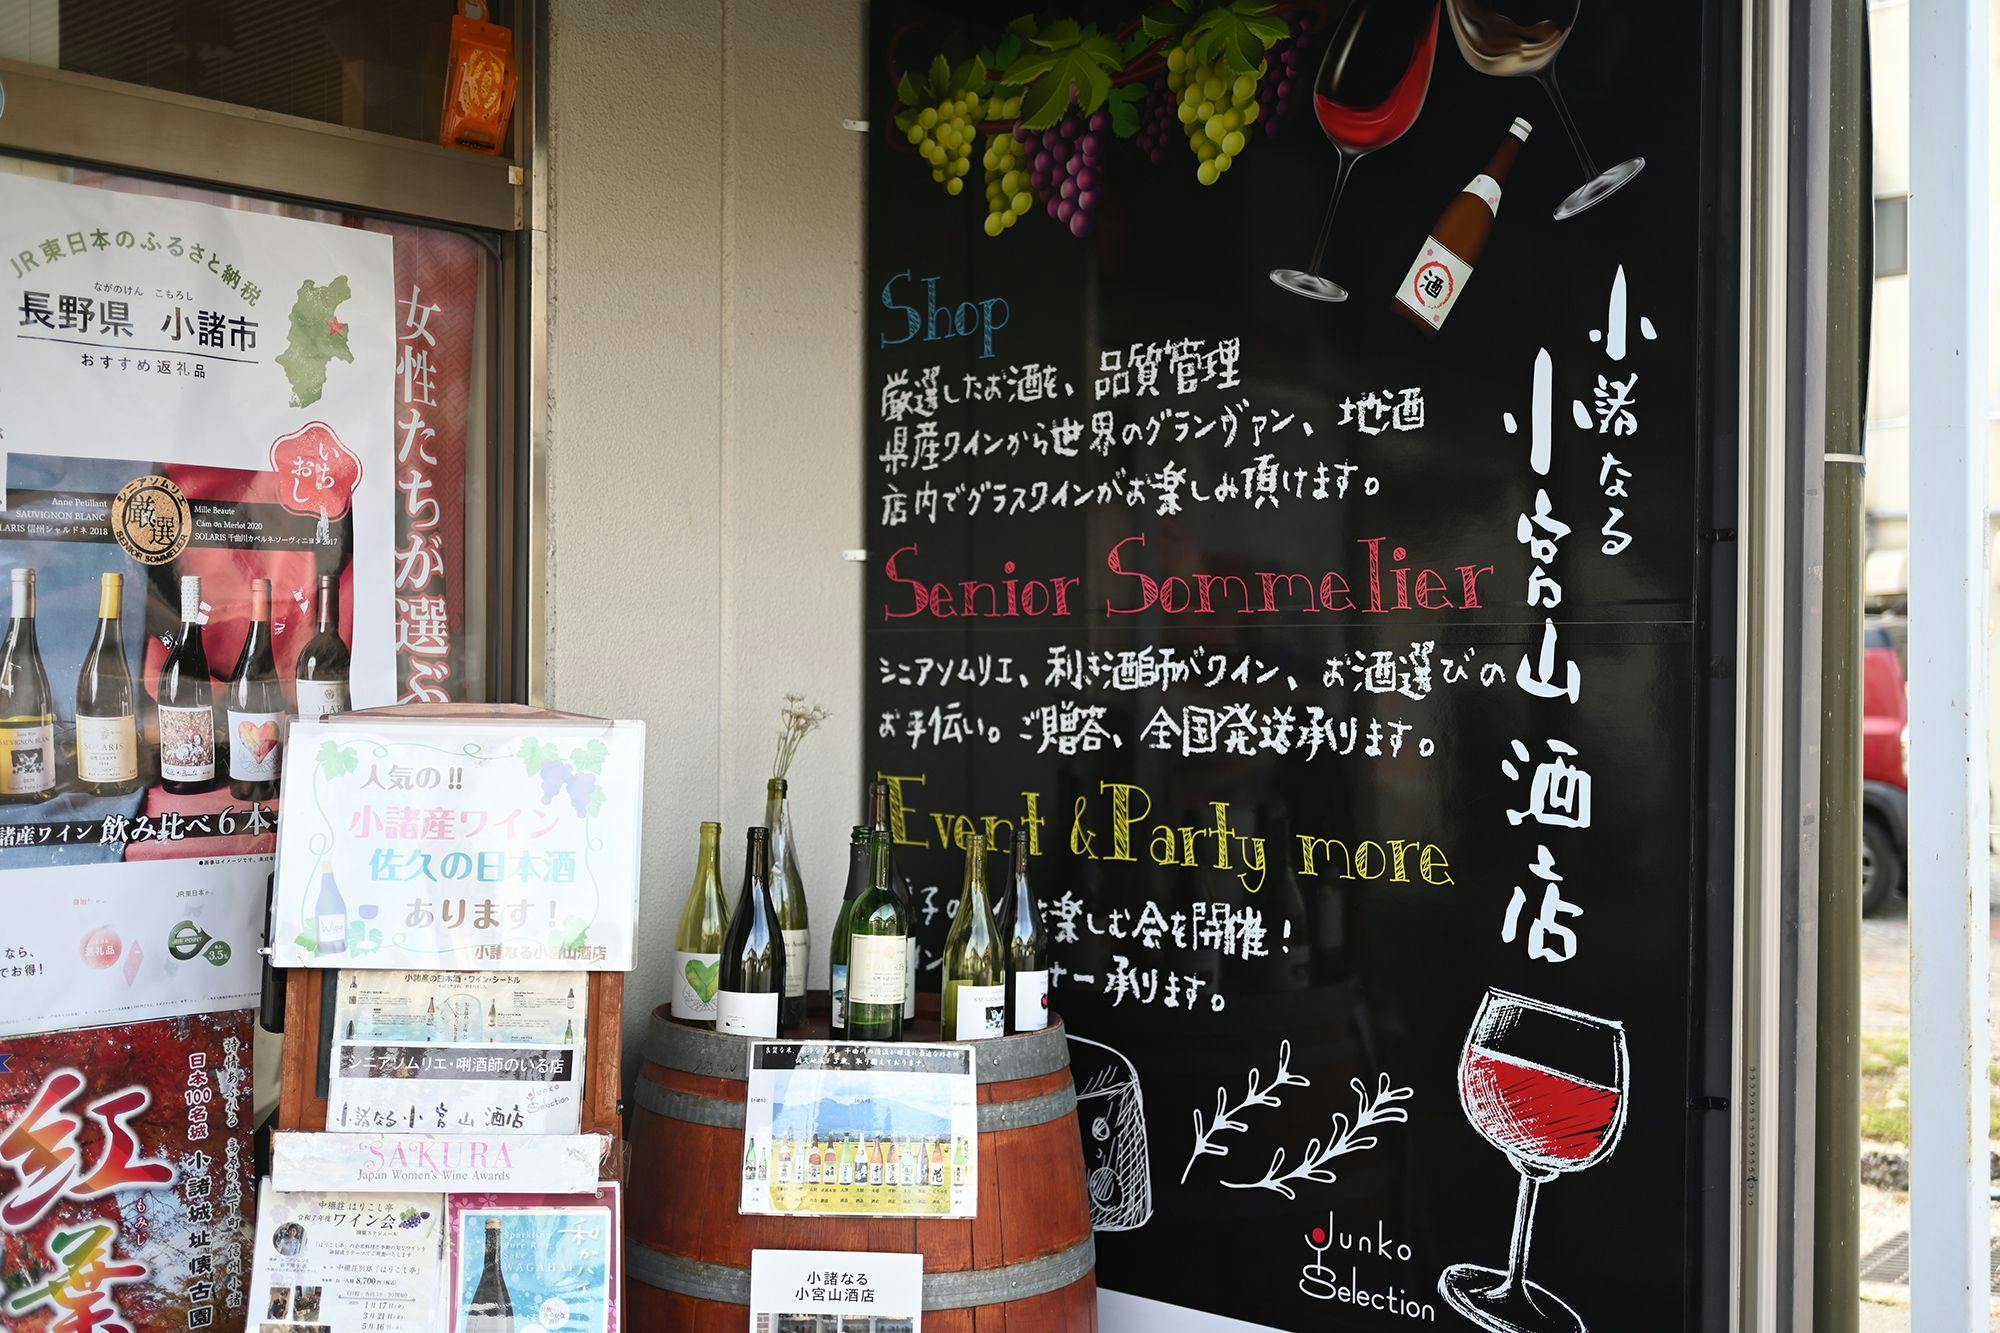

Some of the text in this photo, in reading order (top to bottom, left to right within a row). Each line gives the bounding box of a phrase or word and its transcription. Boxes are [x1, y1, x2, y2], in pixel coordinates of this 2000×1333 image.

[10, 228, 263, 307] JR東日本のふるさと納税
[94, 281, 194, 301] ながのけん こもろし
[1419, 270, 1444, 298] 酒
[18, 290, 259, 352] 長野県 小諸市
[880, 268, 1011, 359] Shop
[81, 353, 206, 379] おすすめ返礼品
[1588, 264, 1657, 555] 小諸なる
[52, 498, 107, 508] Anne Petillant
[117, 477, 187, 508] シニアソムリエ
[394, 285, 449, 703] 女性たちが選ぶ
[16, 510, 106, 522] SAUVIGNON BLANC
[126, 495, 174, 545] 厳選
[194, 505, 235, 516] Mille Beaute
[223, 521, 246, 530] Merlot
[247, 521, 263, 530] 2020
[28, 523, 87, 534] 信州シャルドネ
[89, 527, 109, 536] 2018
[194, 532, 226, 542] SOLARIS
[322, 537, 338, 546] 2017
[116, 531, 187, 562] SENIOR SOMMELIER
[884, 532, 1494, 621] Senior Sommelier
[1502, 347, 1593, 963] 小宮山酒店
[100, 802, 280, 844] 飲み比べ6本
[348, 804, 560, 841] 小諸産ワイン
[877, 771, 1046, 856] Event
[1296, 835, 1454, 885] more
[369, 847, 577, 884] 佐久の日本酒
[405, 898, 558, 930] あります!
[348, 1055, 565, 1075] シニアソムリエ・唎酒師のいる店
[526, 1083, 560, 1100] Junko
[358, 1141, 514, 1174] SAKURA
[185, 1052, 213, 1329] 日本100名城 小諸城址懐古園
[225, 1137, 241, 1231] 高原の城下町
[357, 1169, 510, 1181] Japan Women's Wine Awards
[318, 1200, 394, 1213] 中棚荘 はりこし亭
[333, 1213, 396, 1229] ワイン会
[136, 1200, 149, 1246] もみじ
[1304, 1211, 1412, 1261] Junko
[226, 1243, 242, 1307] 信州小諸
[807, 1271, 869, 1286] 小諸なる
[795, 1287, 875, 1303] 小宮山酒店
[1299, 1265, 1435, 1322] Selection
